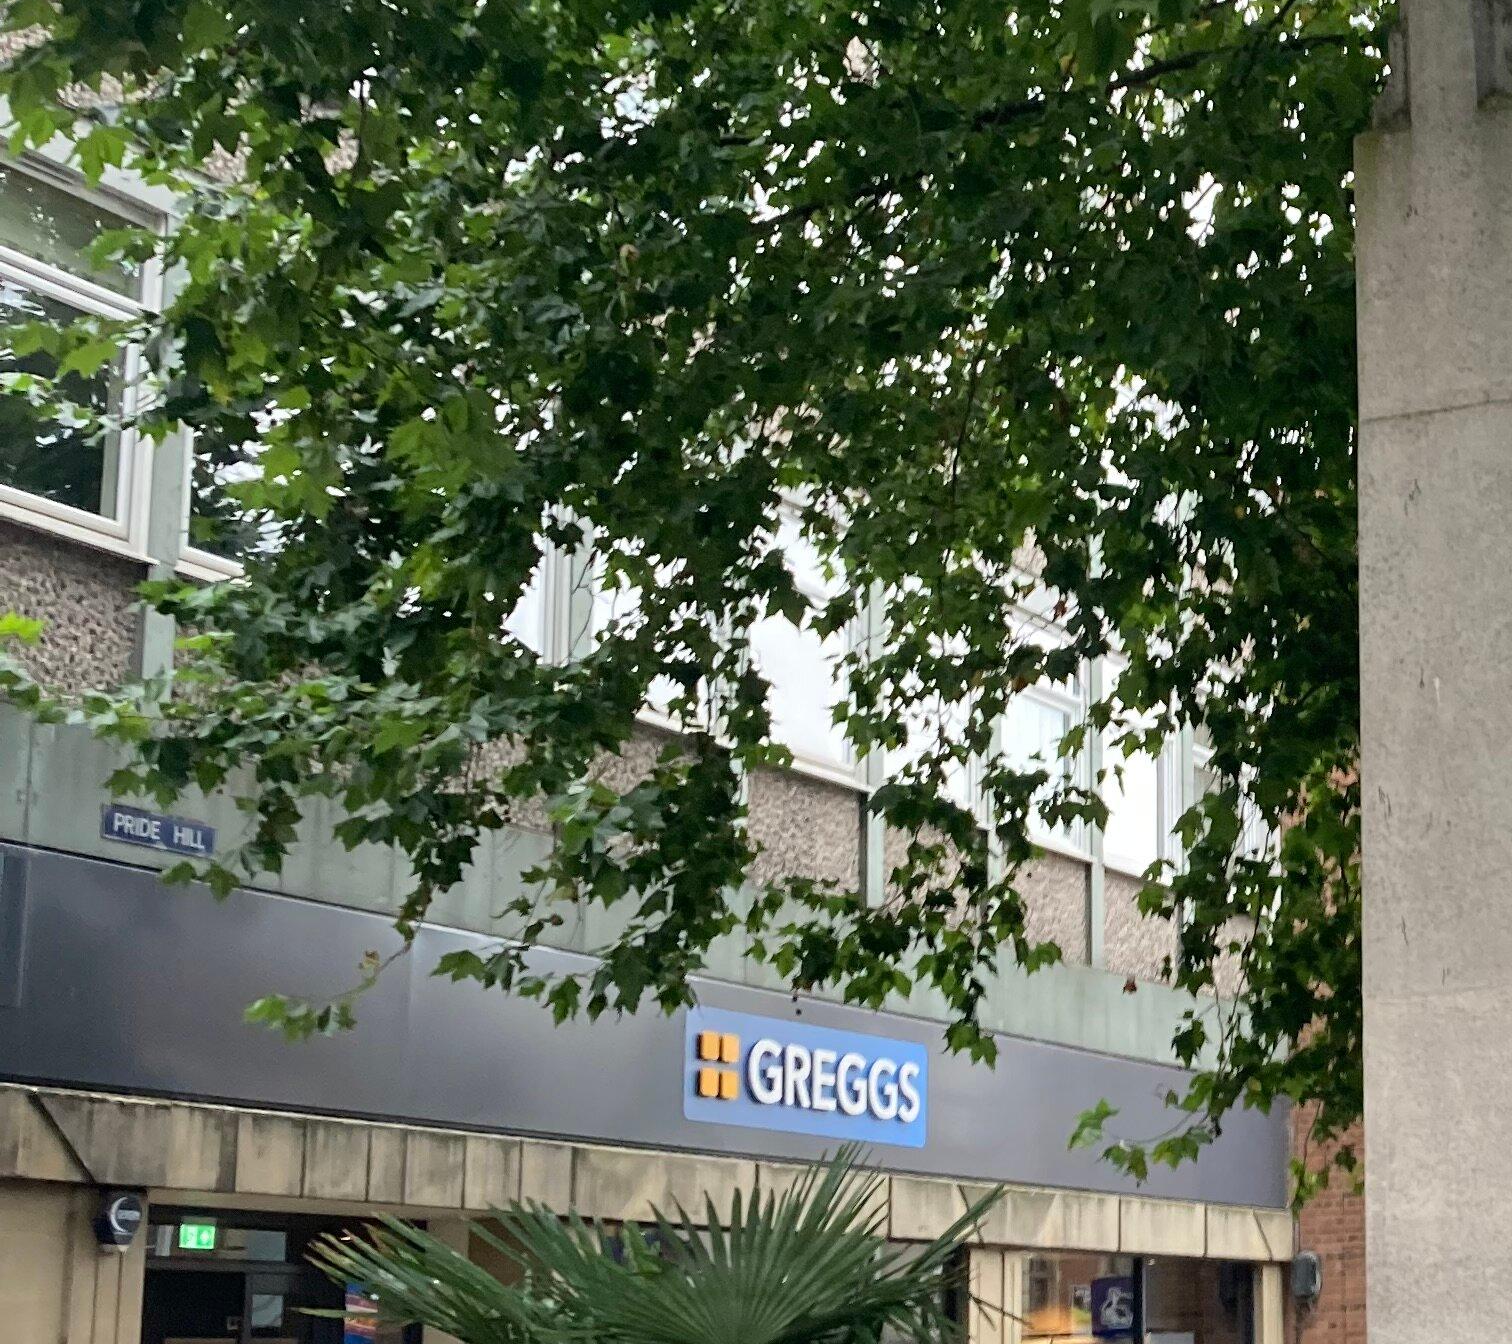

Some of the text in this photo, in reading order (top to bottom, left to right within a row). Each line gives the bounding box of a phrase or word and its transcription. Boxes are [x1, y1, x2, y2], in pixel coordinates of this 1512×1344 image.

[113, 812, 205, 849] PRIDE HILL
[746, 1038, 921, 1124] GREGGS
